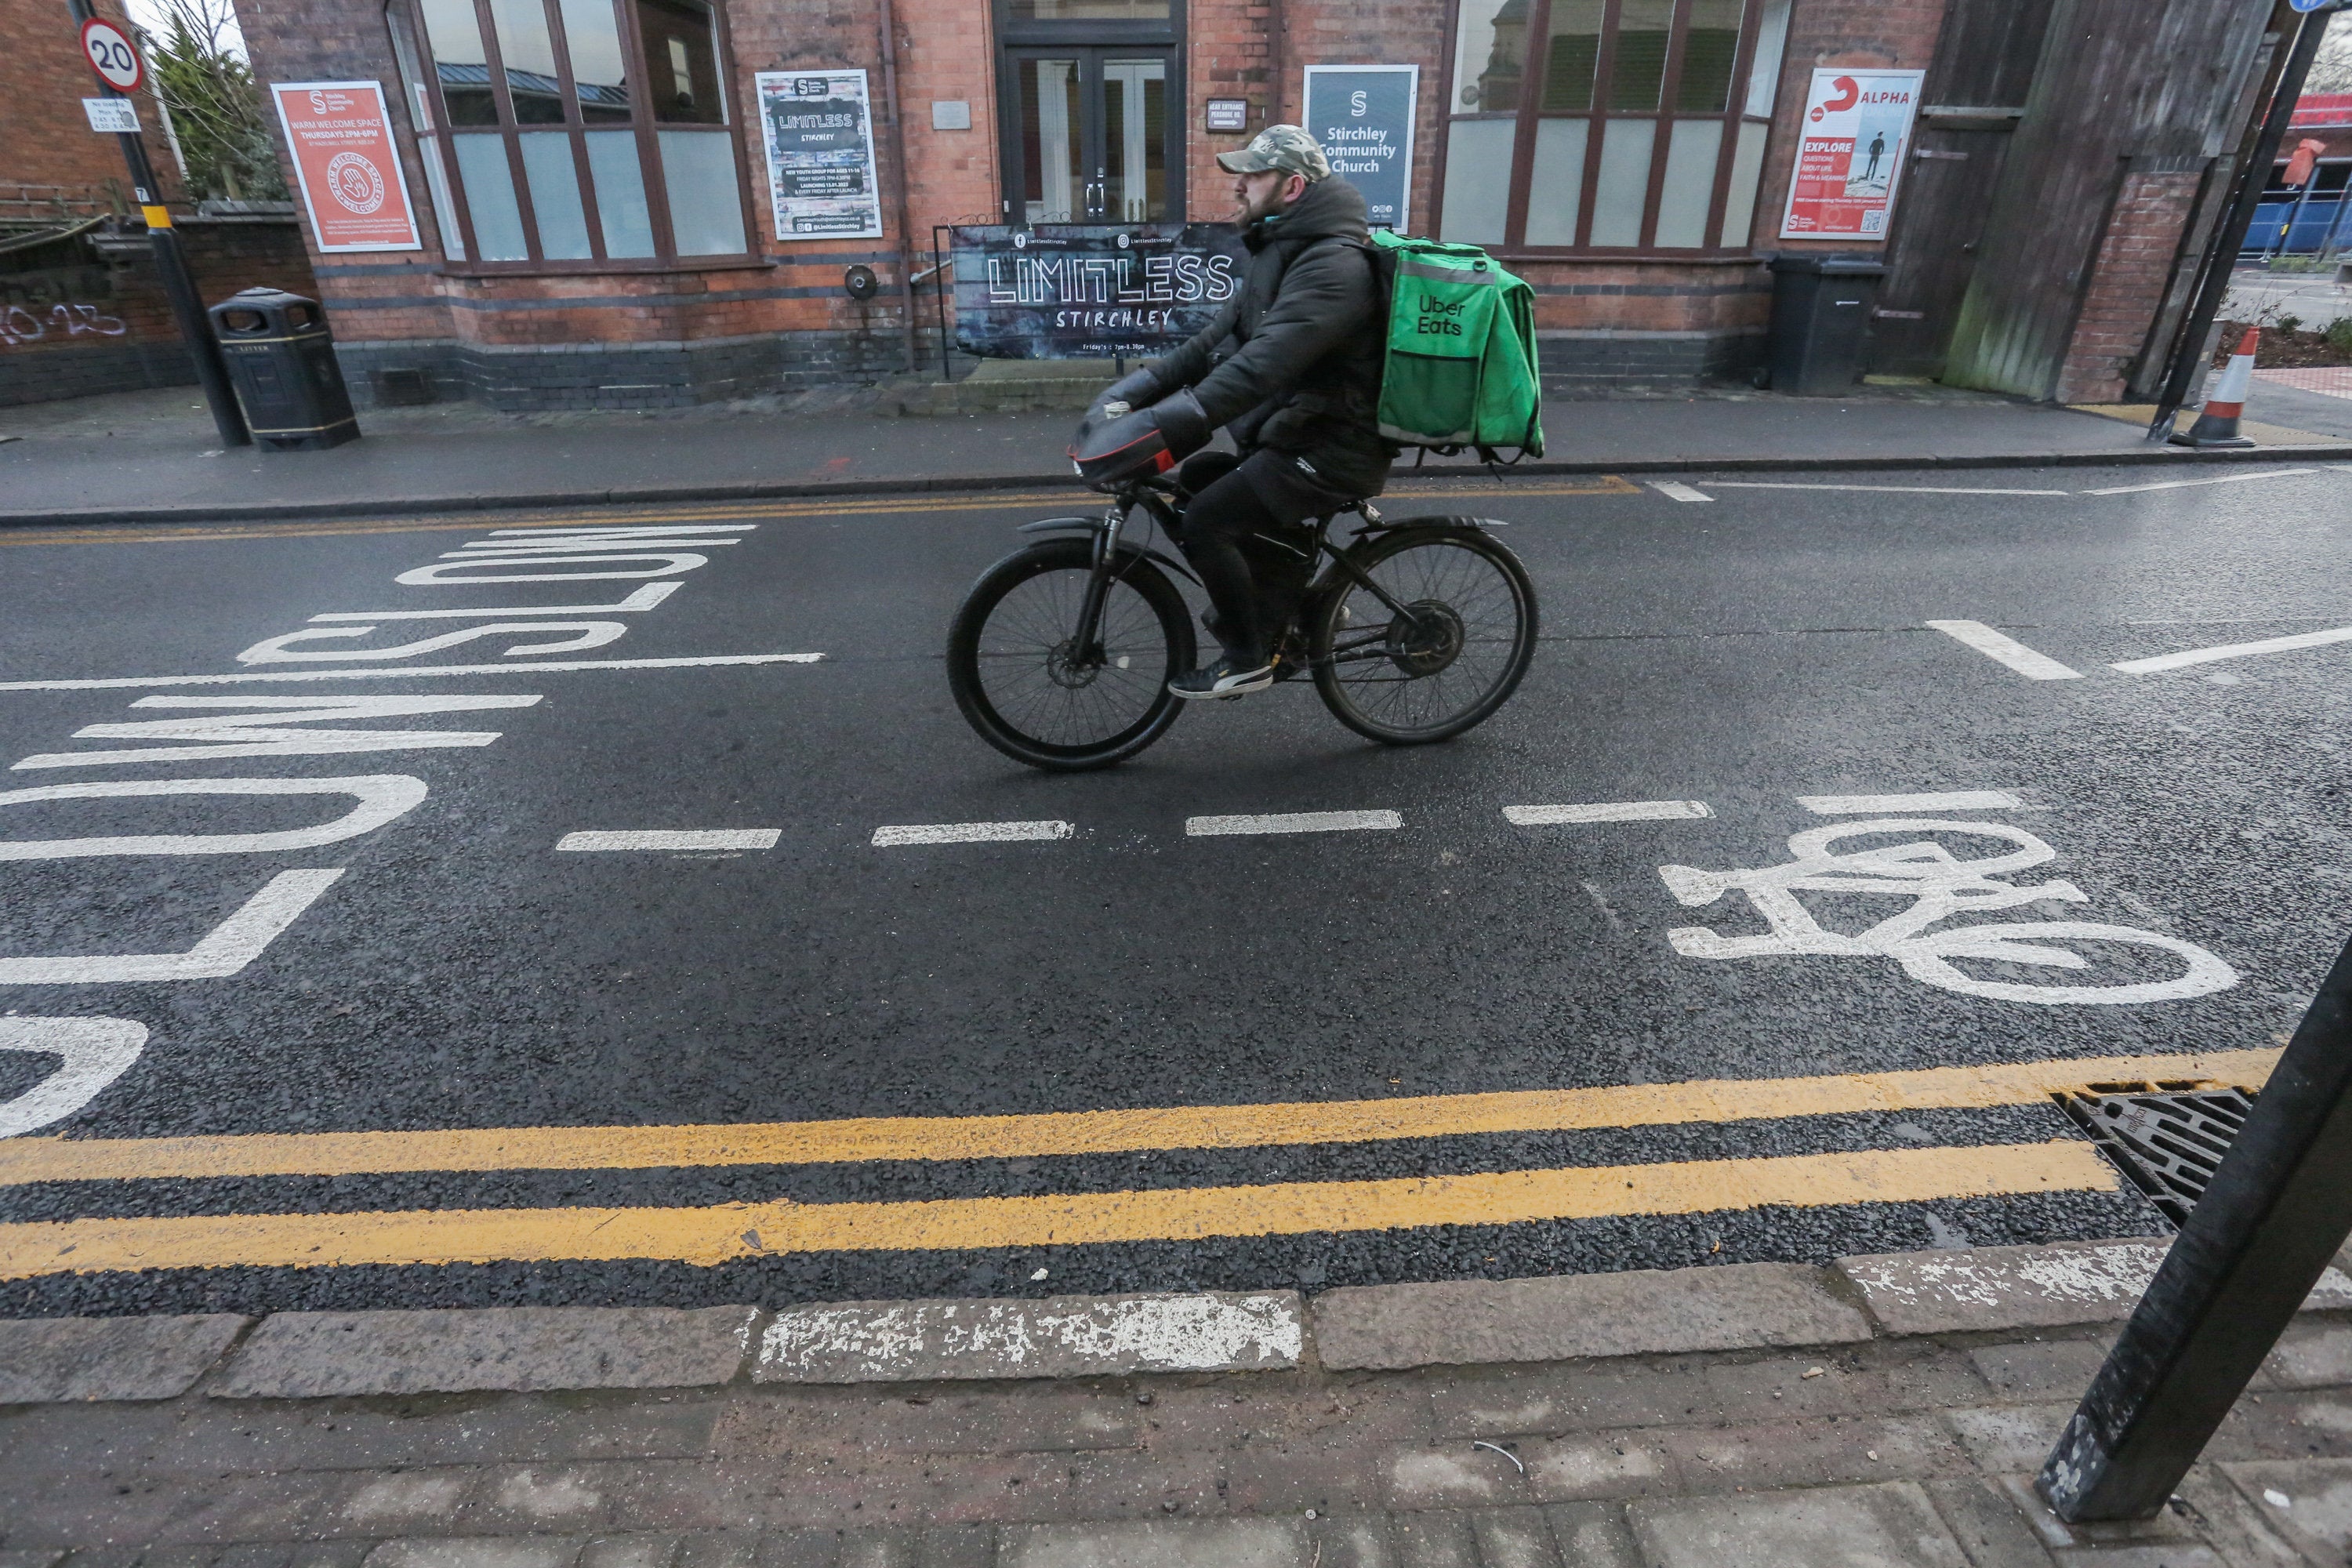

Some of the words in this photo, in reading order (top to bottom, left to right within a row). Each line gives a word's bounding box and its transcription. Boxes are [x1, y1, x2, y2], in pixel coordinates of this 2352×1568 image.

[91, 39, 132, 71] 20
[309, 90, 327, 114] S
[1351, 90, 1367, 117] S
[1860, 92, 1909, 103] ALPHA
[291, 121, 315, 129] WARM
[317, 120, 356, 129] WELCOME
[779, 114, 853, 129] LIMITLESS
[300, 130, 344, 139] THURSDAYS
[800, 132, 835, 141] STIRCHLEY
[1327, 126, 1388, 143] Stirchley
[1804, 142, 1853, 152] EXPLORE
[332, 154, 368, 169] WELCOME
[1332, 159, 1379, 172] Church
[328, 170, 342, 198] WARM
[368, 166, 383, 196] SPACE
[343, 197, 381, 212] WELCOME
[988, 255, 1234, 303] LIMITLESS
[1419, 294, 1466, 318] Uber
[1056, 307, 1172, 328] STIRCHLEY
[1417, 316, 1462, 336] Eats
[236, 524, 759, 666] SLOW
